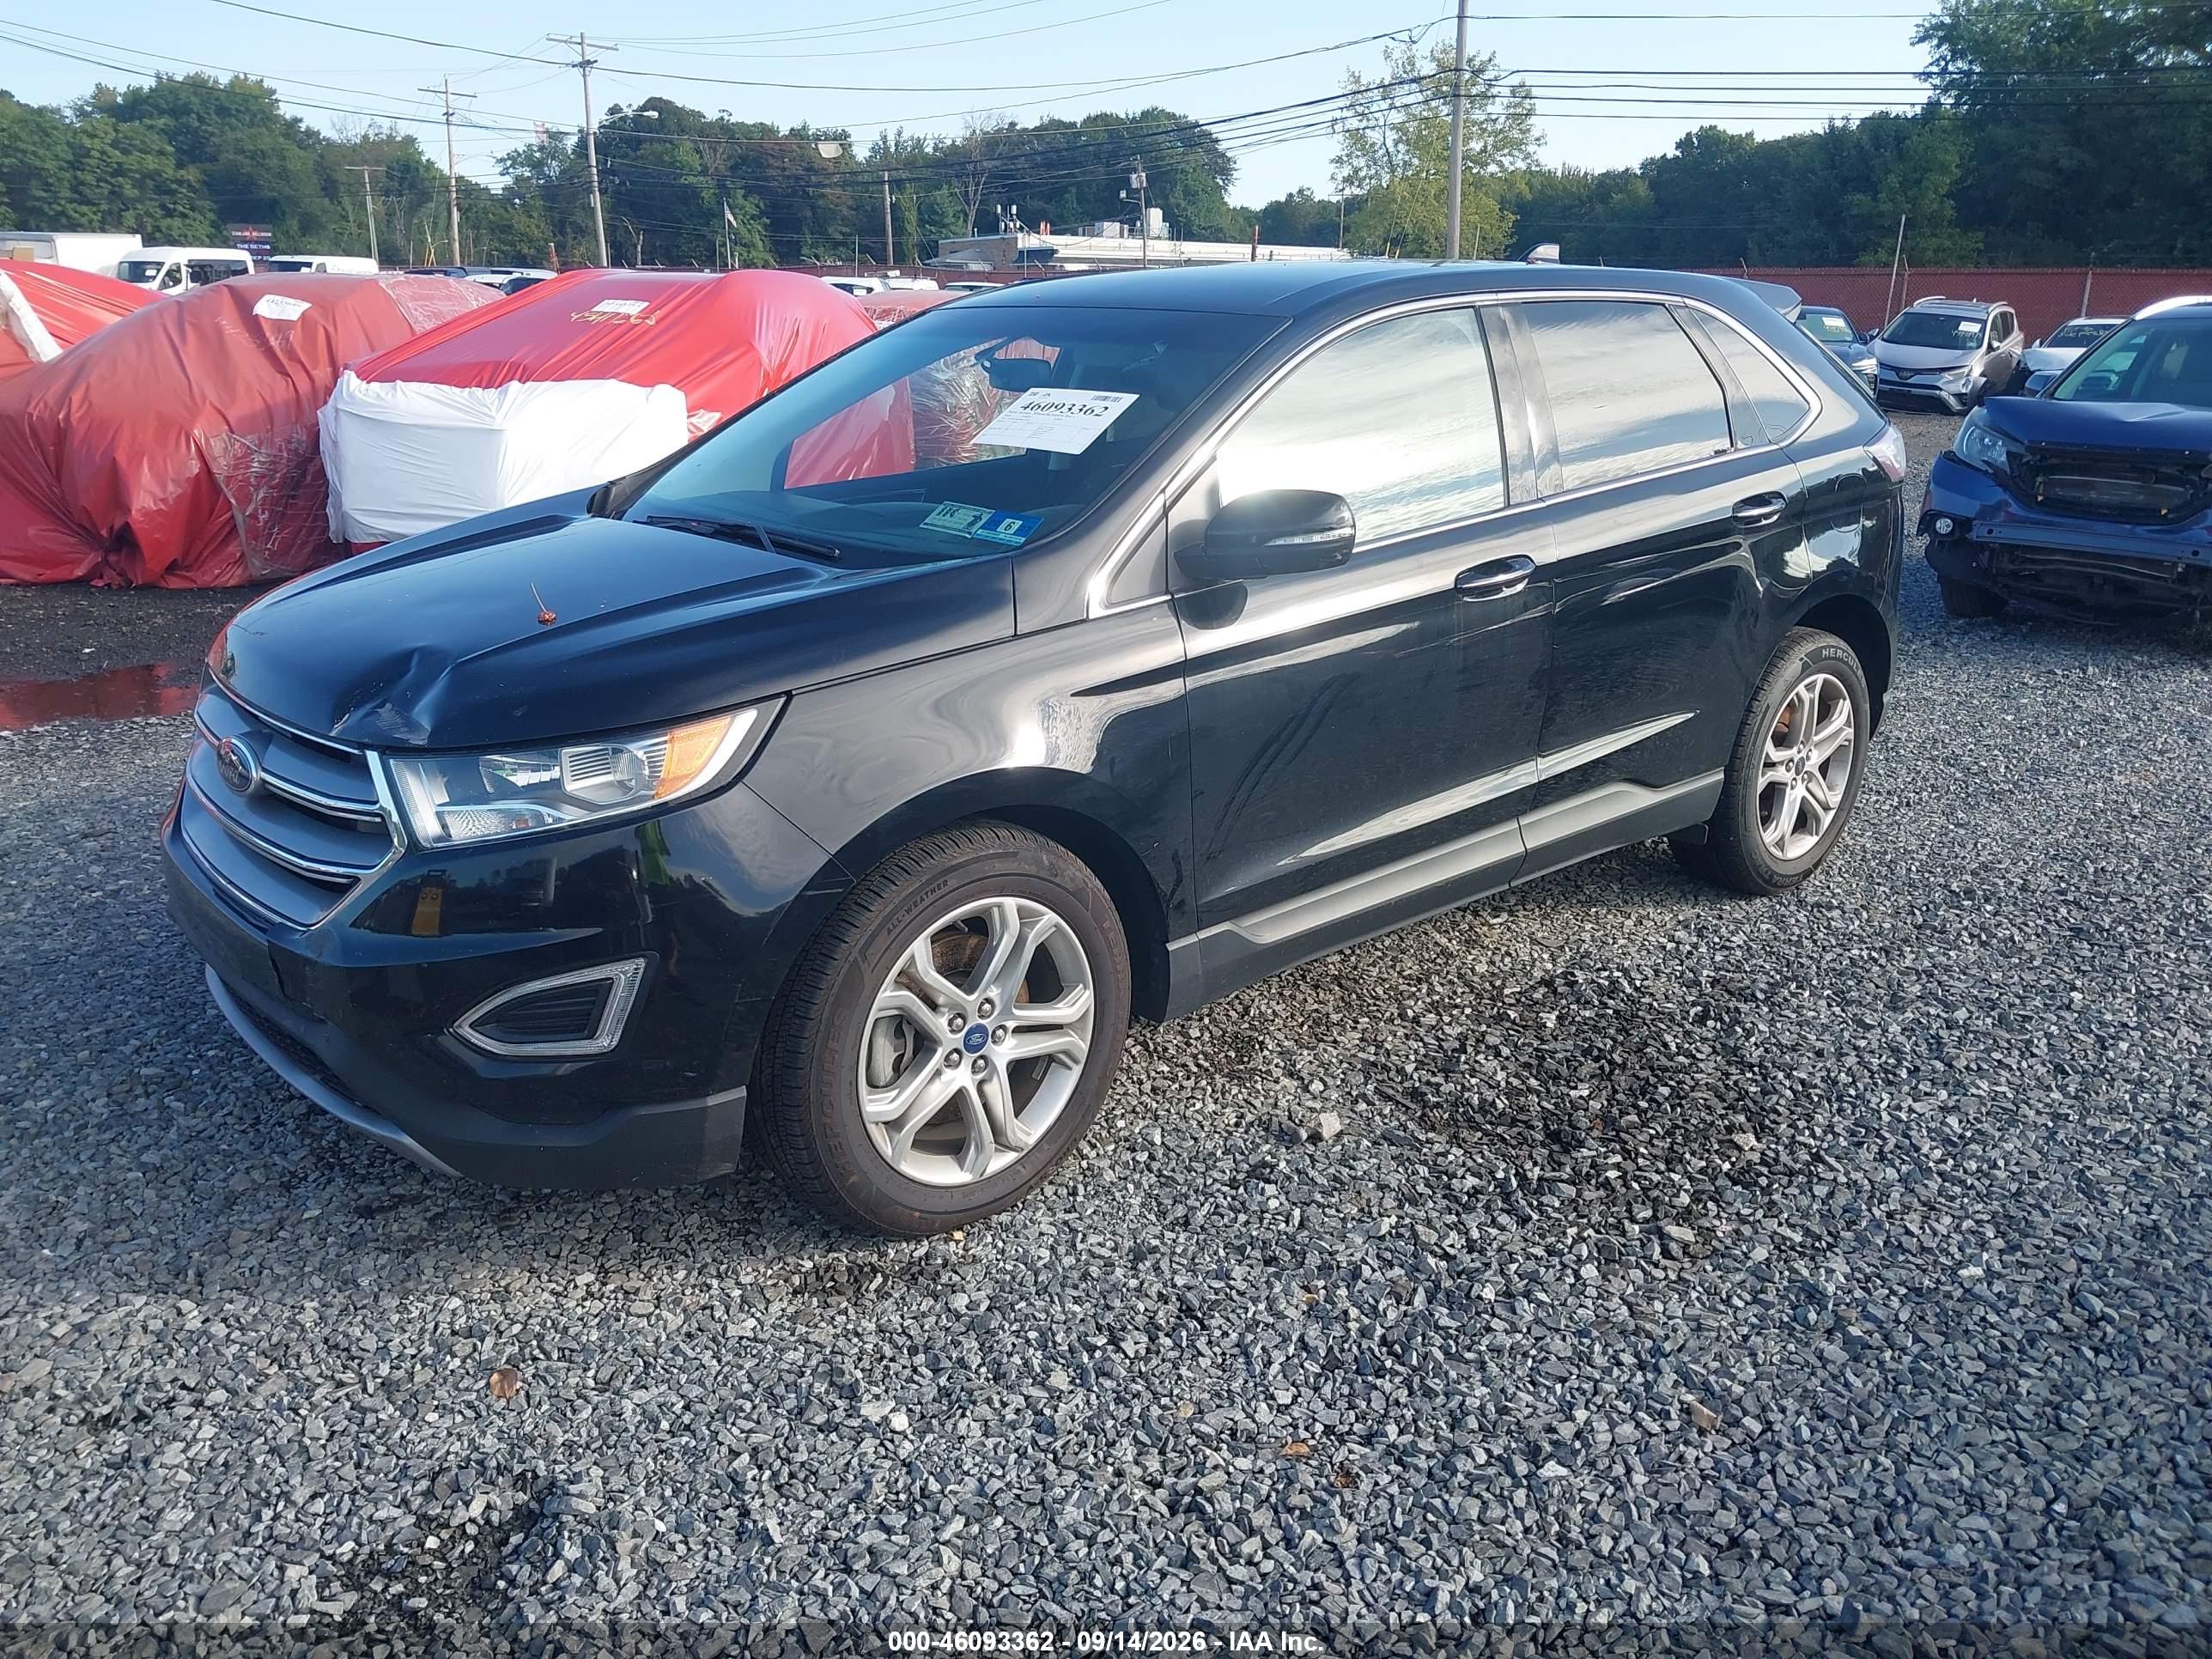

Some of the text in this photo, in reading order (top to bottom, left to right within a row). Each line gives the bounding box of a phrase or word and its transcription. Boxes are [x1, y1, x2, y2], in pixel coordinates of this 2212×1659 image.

[1020, 400, 1109, 417] 46093362
[1003, 521, 1016, 532] 6
[886, 879, 950, 936] ALL-WEATHER
